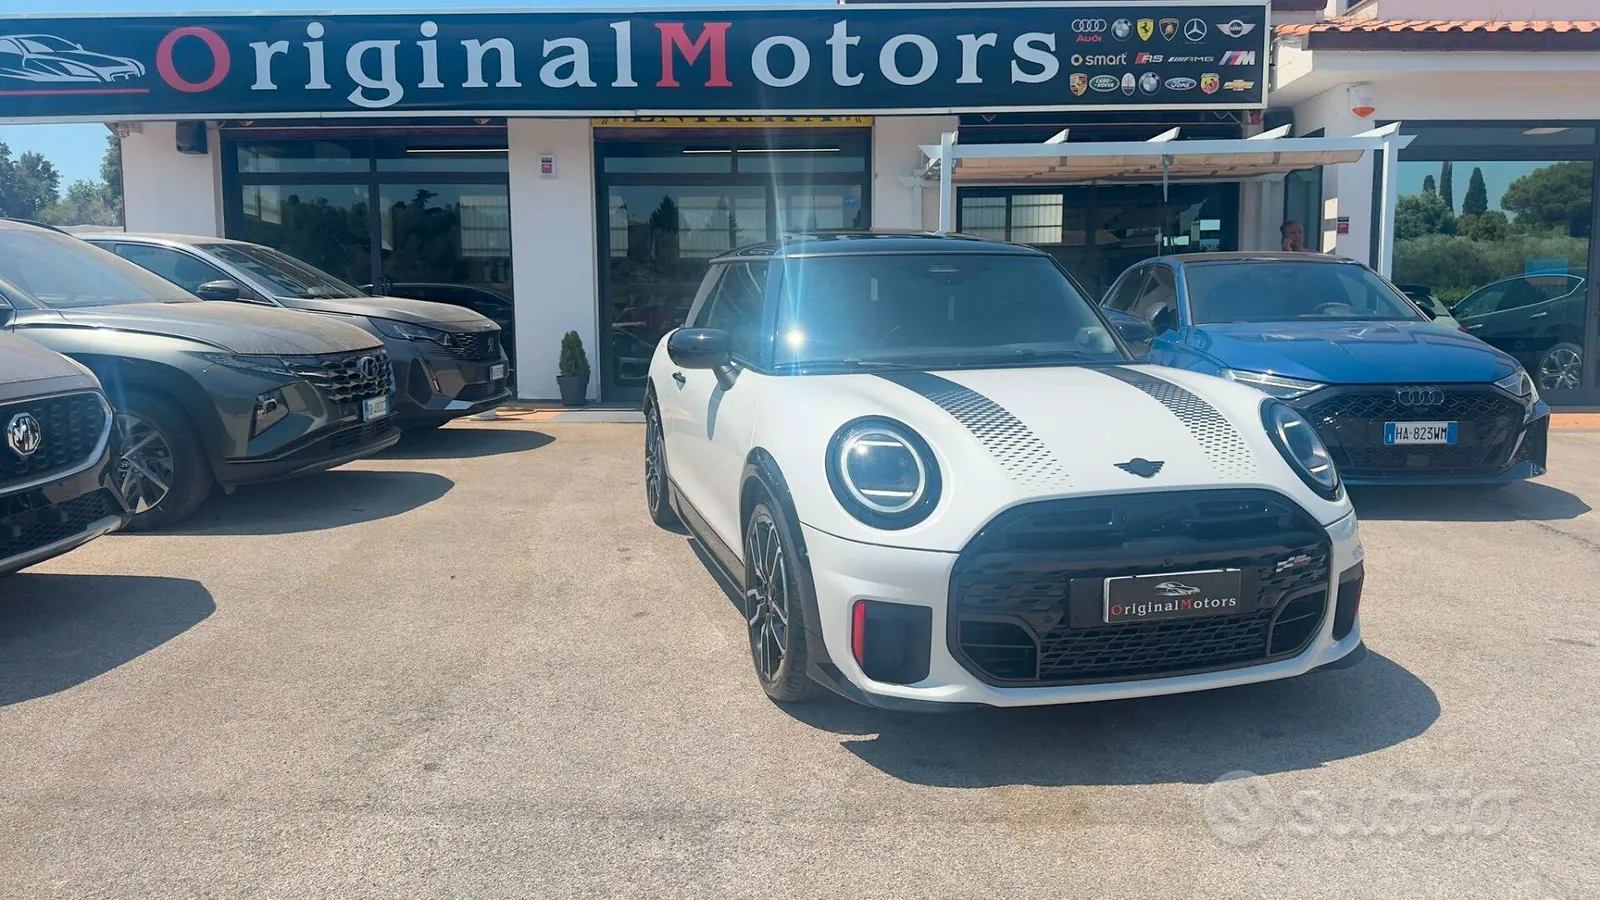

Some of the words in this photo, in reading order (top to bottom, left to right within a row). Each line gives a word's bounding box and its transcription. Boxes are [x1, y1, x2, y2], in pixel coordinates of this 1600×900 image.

[1075, 34, 1102, 42] Audi
[1085, 53, 1127, 66] smart
[1141, 54, 1164, 63] RS
